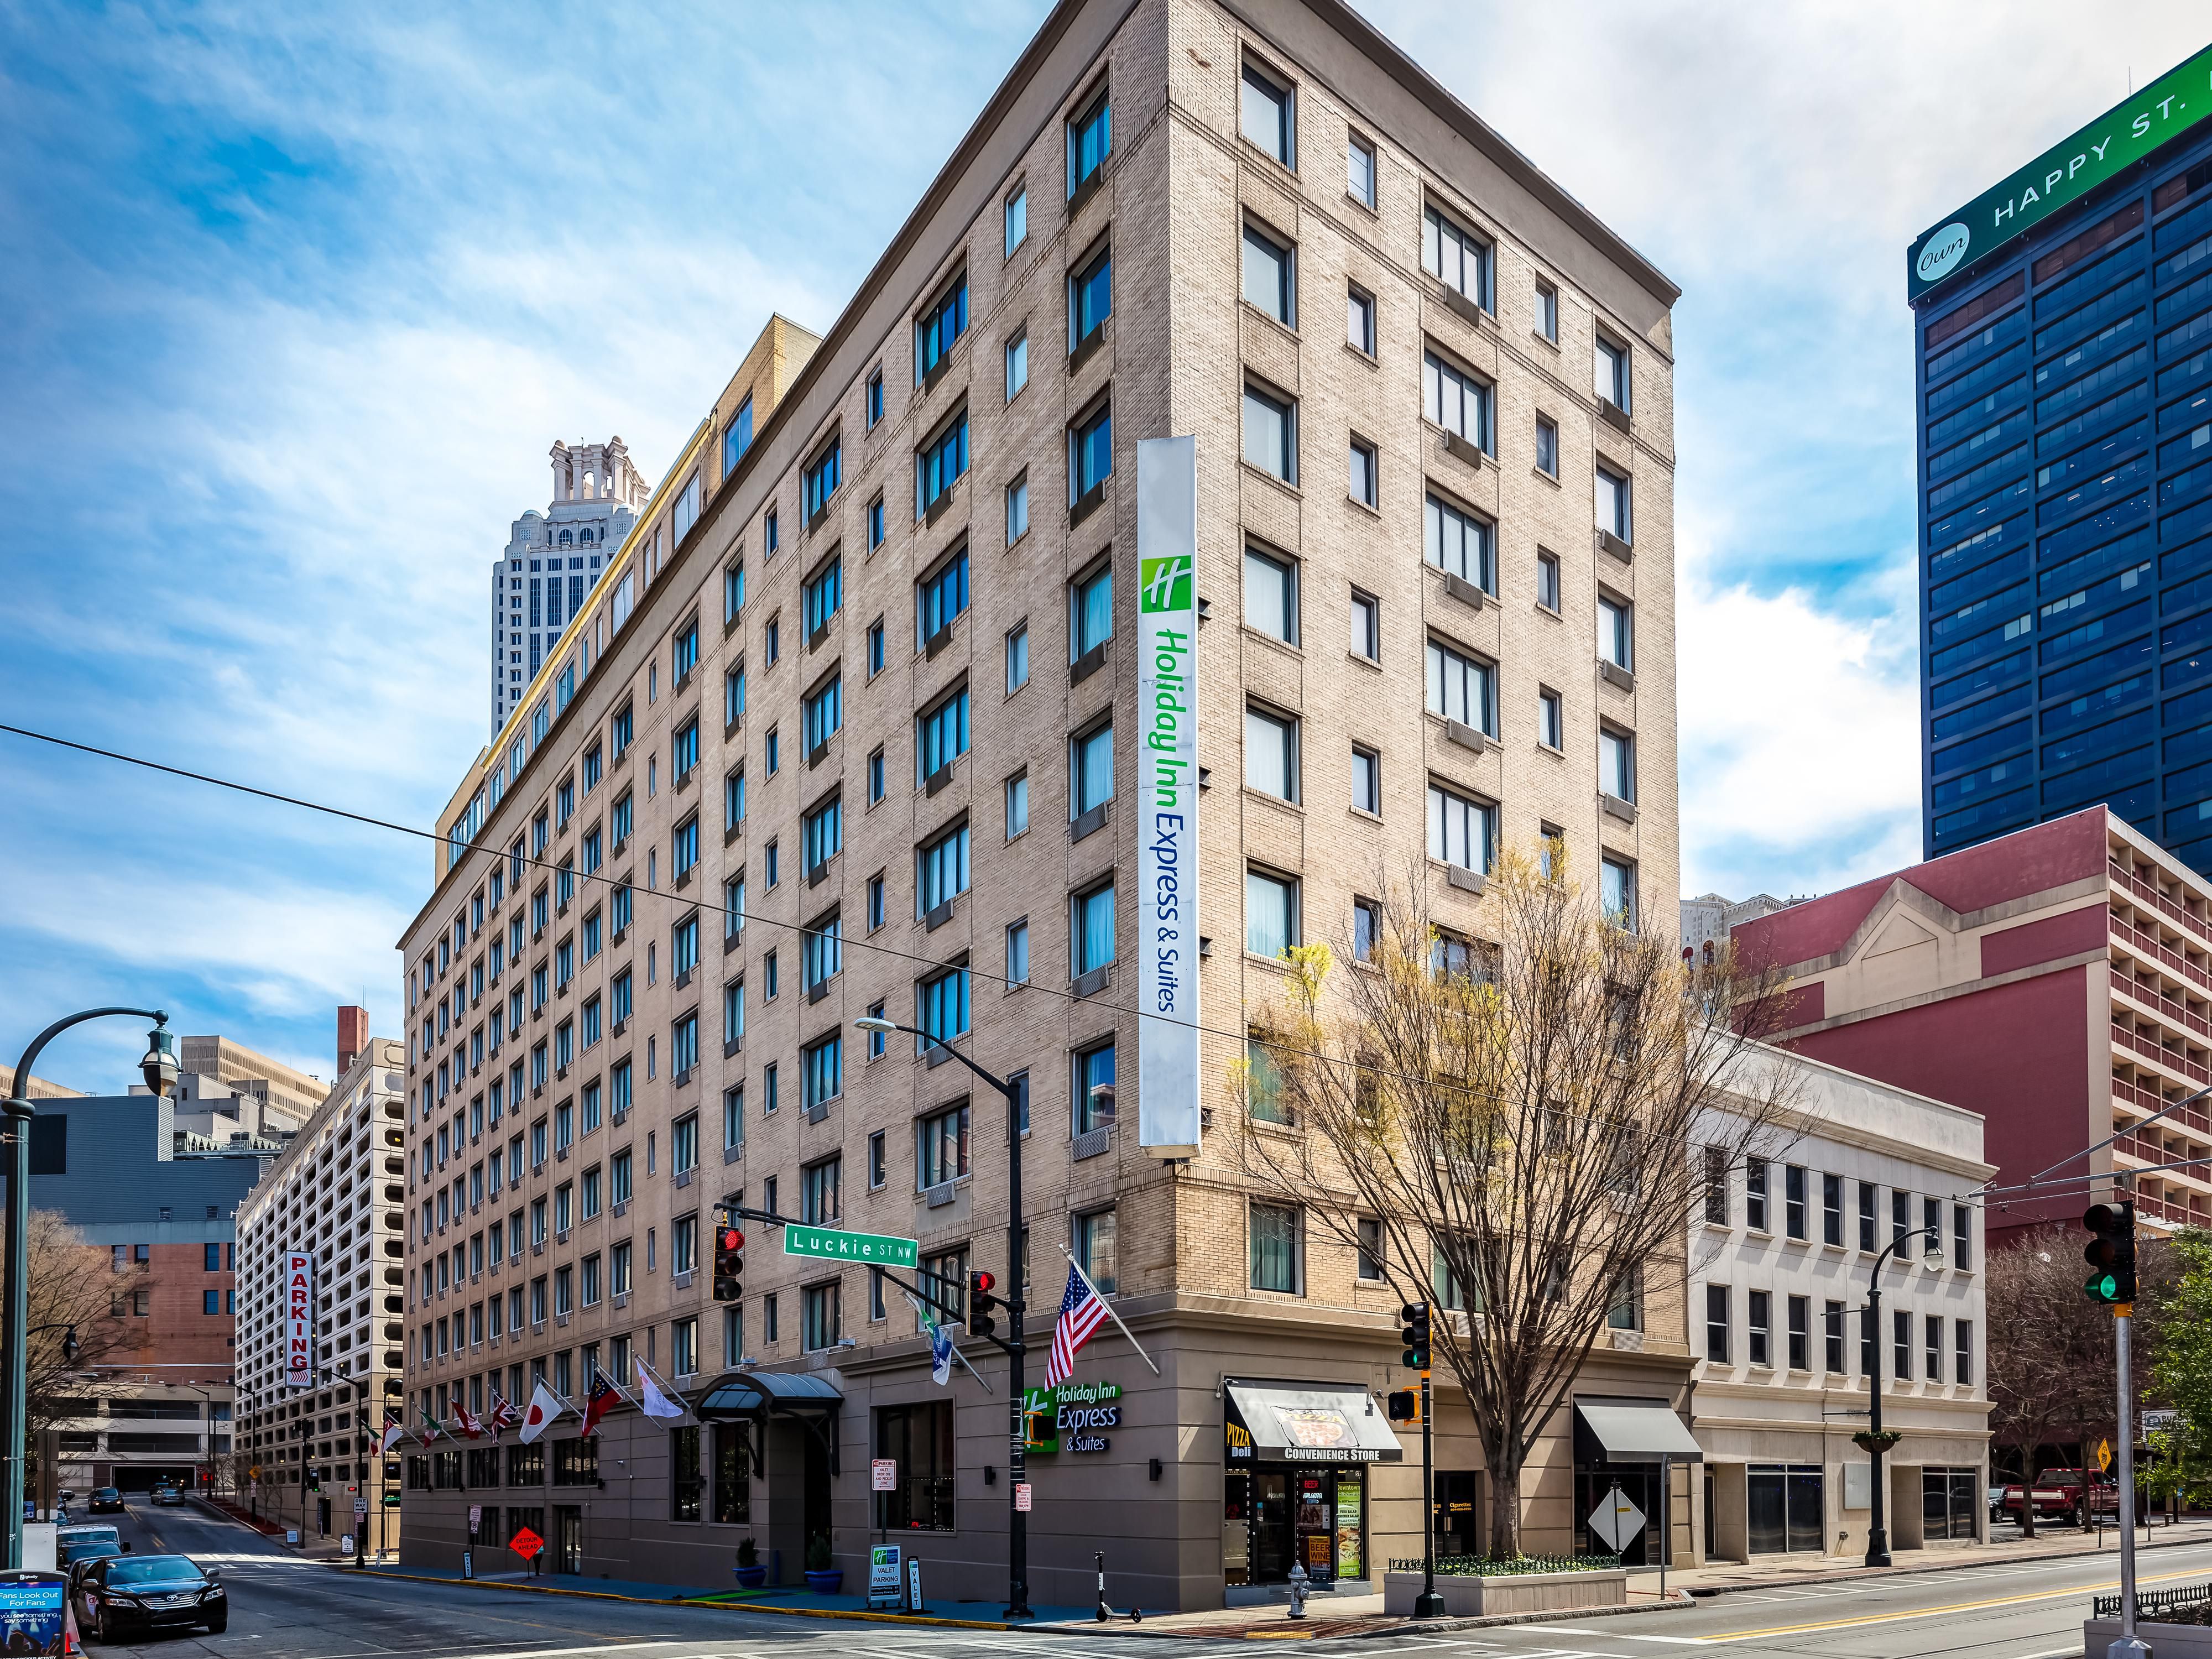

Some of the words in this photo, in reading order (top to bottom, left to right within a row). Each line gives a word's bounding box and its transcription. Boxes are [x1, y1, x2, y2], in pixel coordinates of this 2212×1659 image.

[1995, 135, 2111, 227] HAPPY
[2131, 94, 2186, 139] ST.
[1920, 236, 1966, 272] Own
[1147, 628, 1188, 753] Holiday
[1156, 759, 1188, 807] Inn
[1149, 813, 1184, 921] Express
[1157, 927, 1179, 943] &
[1157, 947, 1179, 1013] Suites
[794, 1232, 872, 1256] Luckie
[879, 1244, 893, 1256] ST
[898, 1246, 911, 1259] NW
[290, 1256, 309, 1368] PARKING
[1056, 1384, 1097, 1404] Holiday
[1098, 1381, 1116, 1399] Inn
[1057, 1405, 1117, 1434] Express
[1066, 1437, 1073, 1451] &
[1075, 1436, 1105, 1451] Suites
[1227, 1422, 1250, 1447] PIZZA
[1232, 1447, 1251, 1457] Deli
[1285, 1447, 1349, 1460] CONVENIENCE
[1350, 1448, 1380, 1460] STORE
